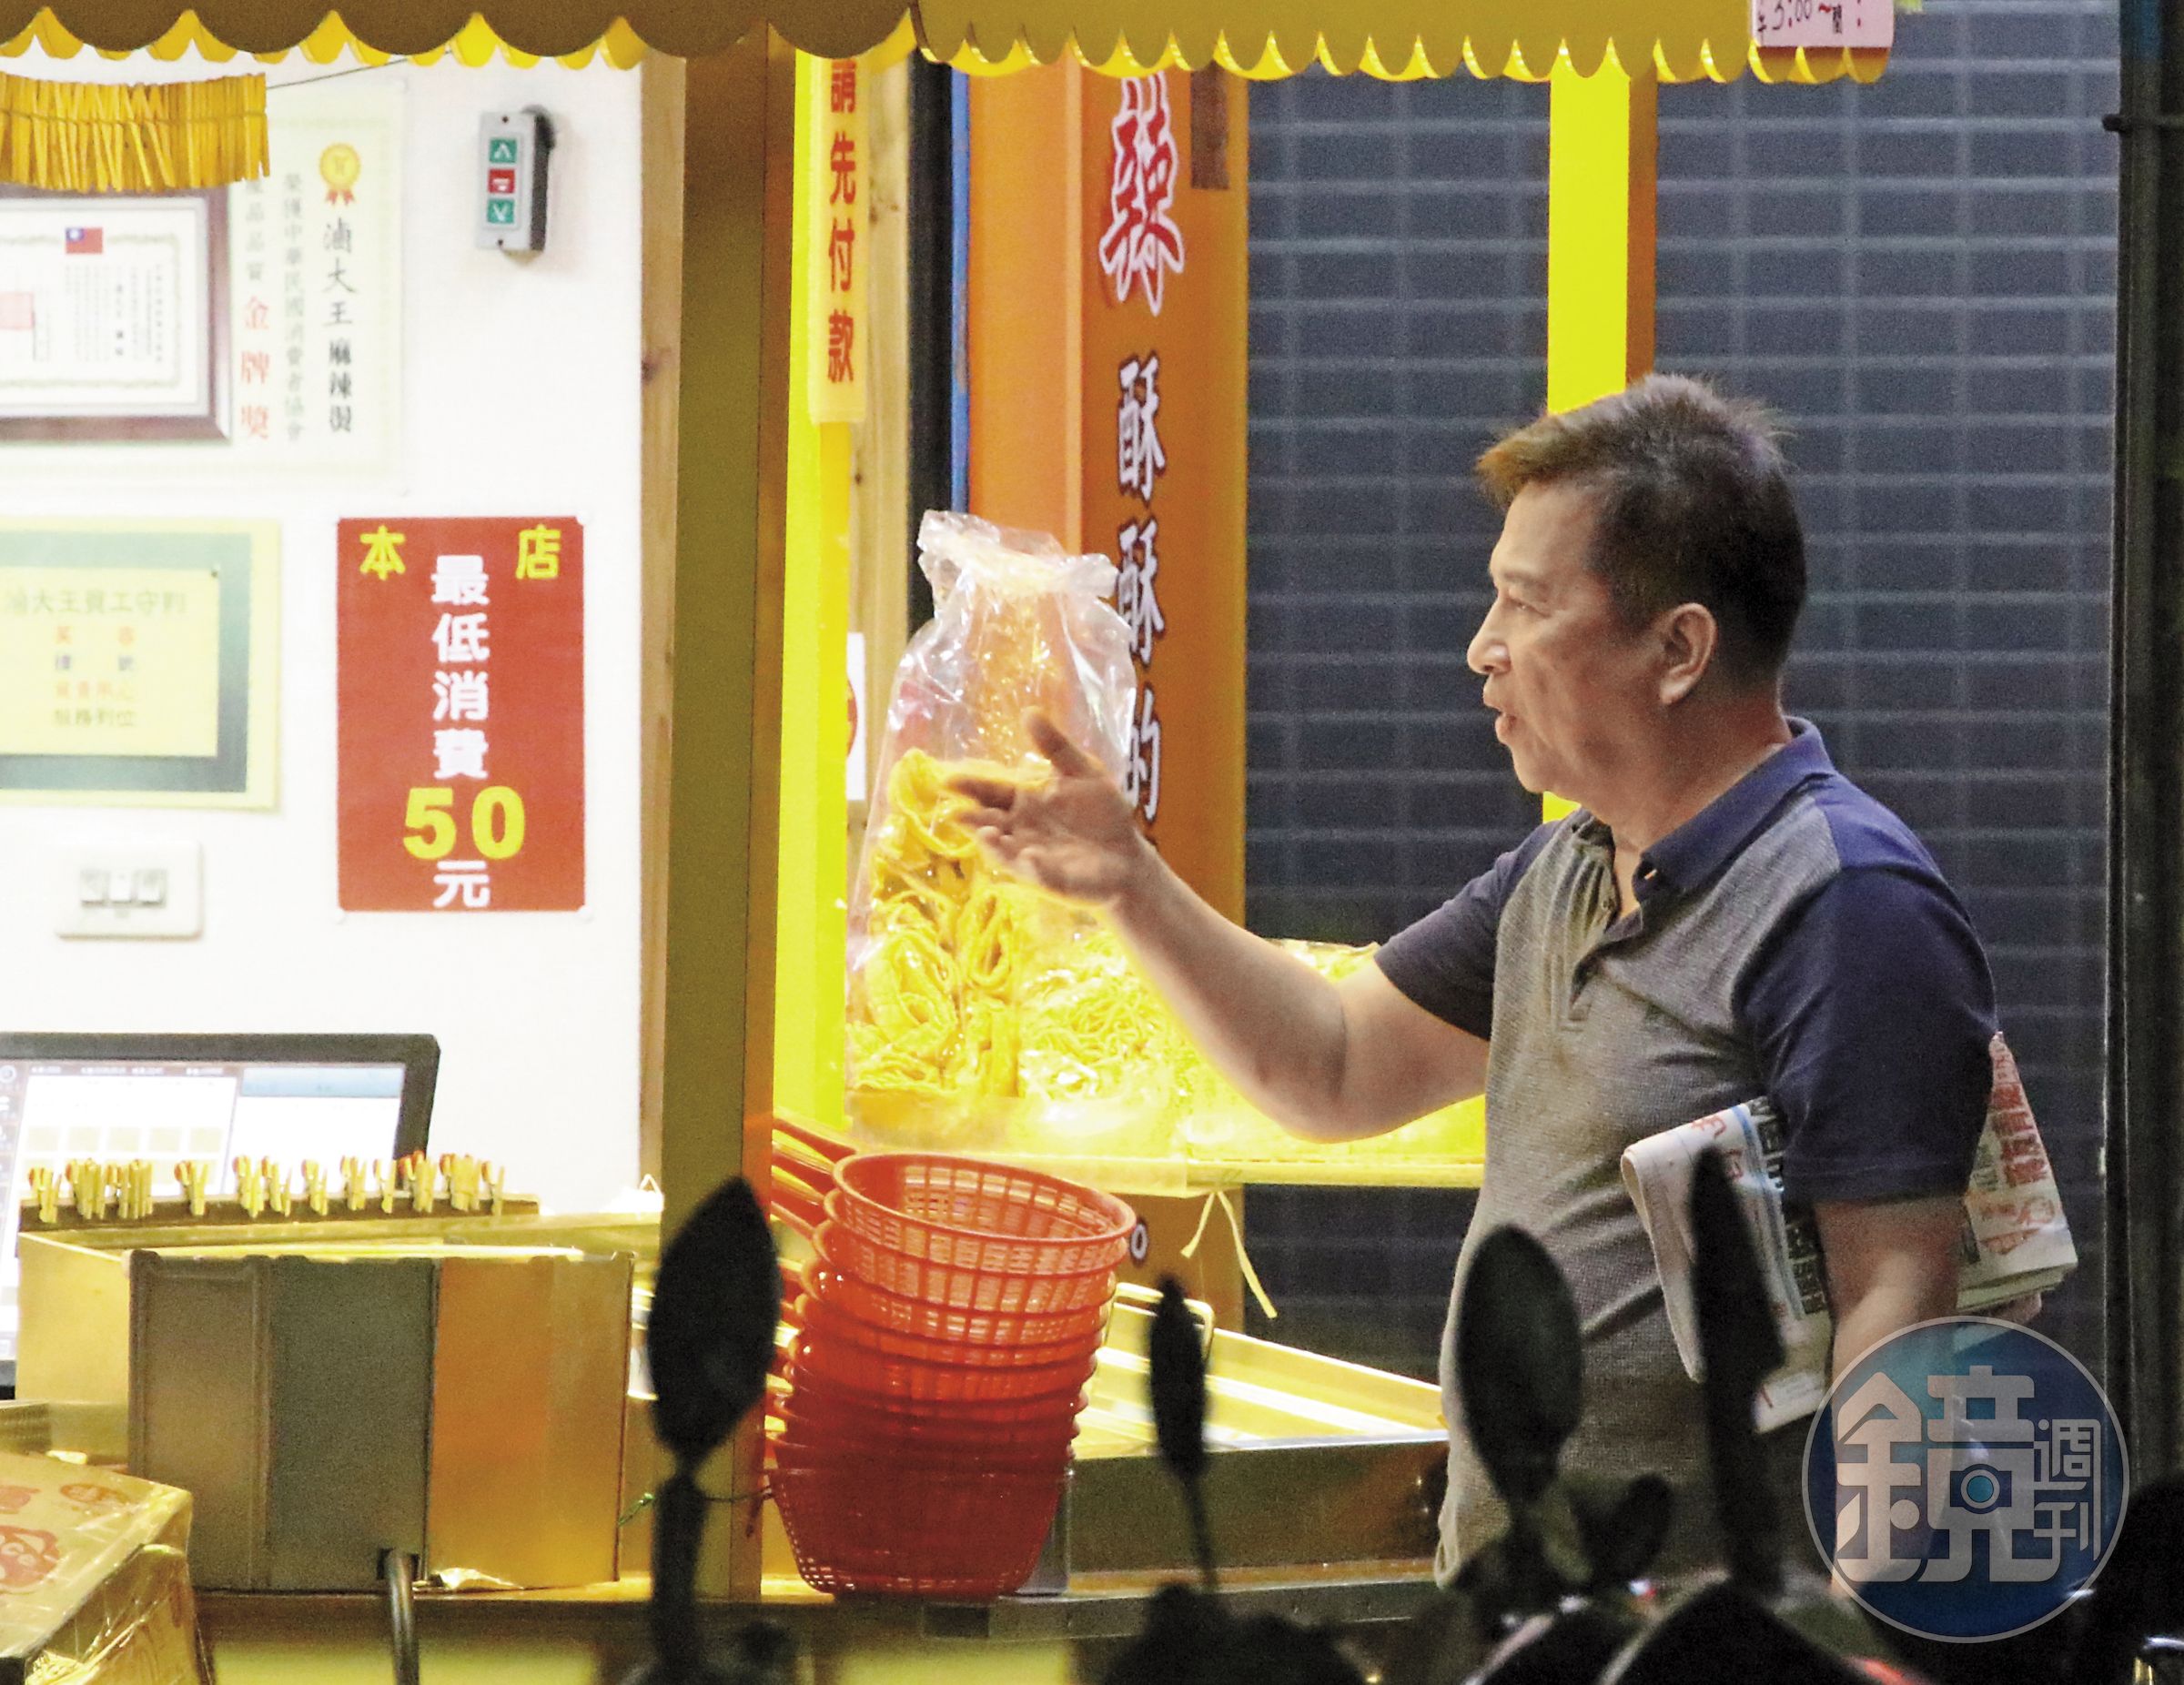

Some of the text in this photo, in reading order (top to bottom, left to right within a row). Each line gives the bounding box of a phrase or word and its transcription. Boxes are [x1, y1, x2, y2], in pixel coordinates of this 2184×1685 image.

[430, 554, 490, 779] 最低消費
[402, 785, 526, 860] 50
[433, 860, 491, 908] 元
